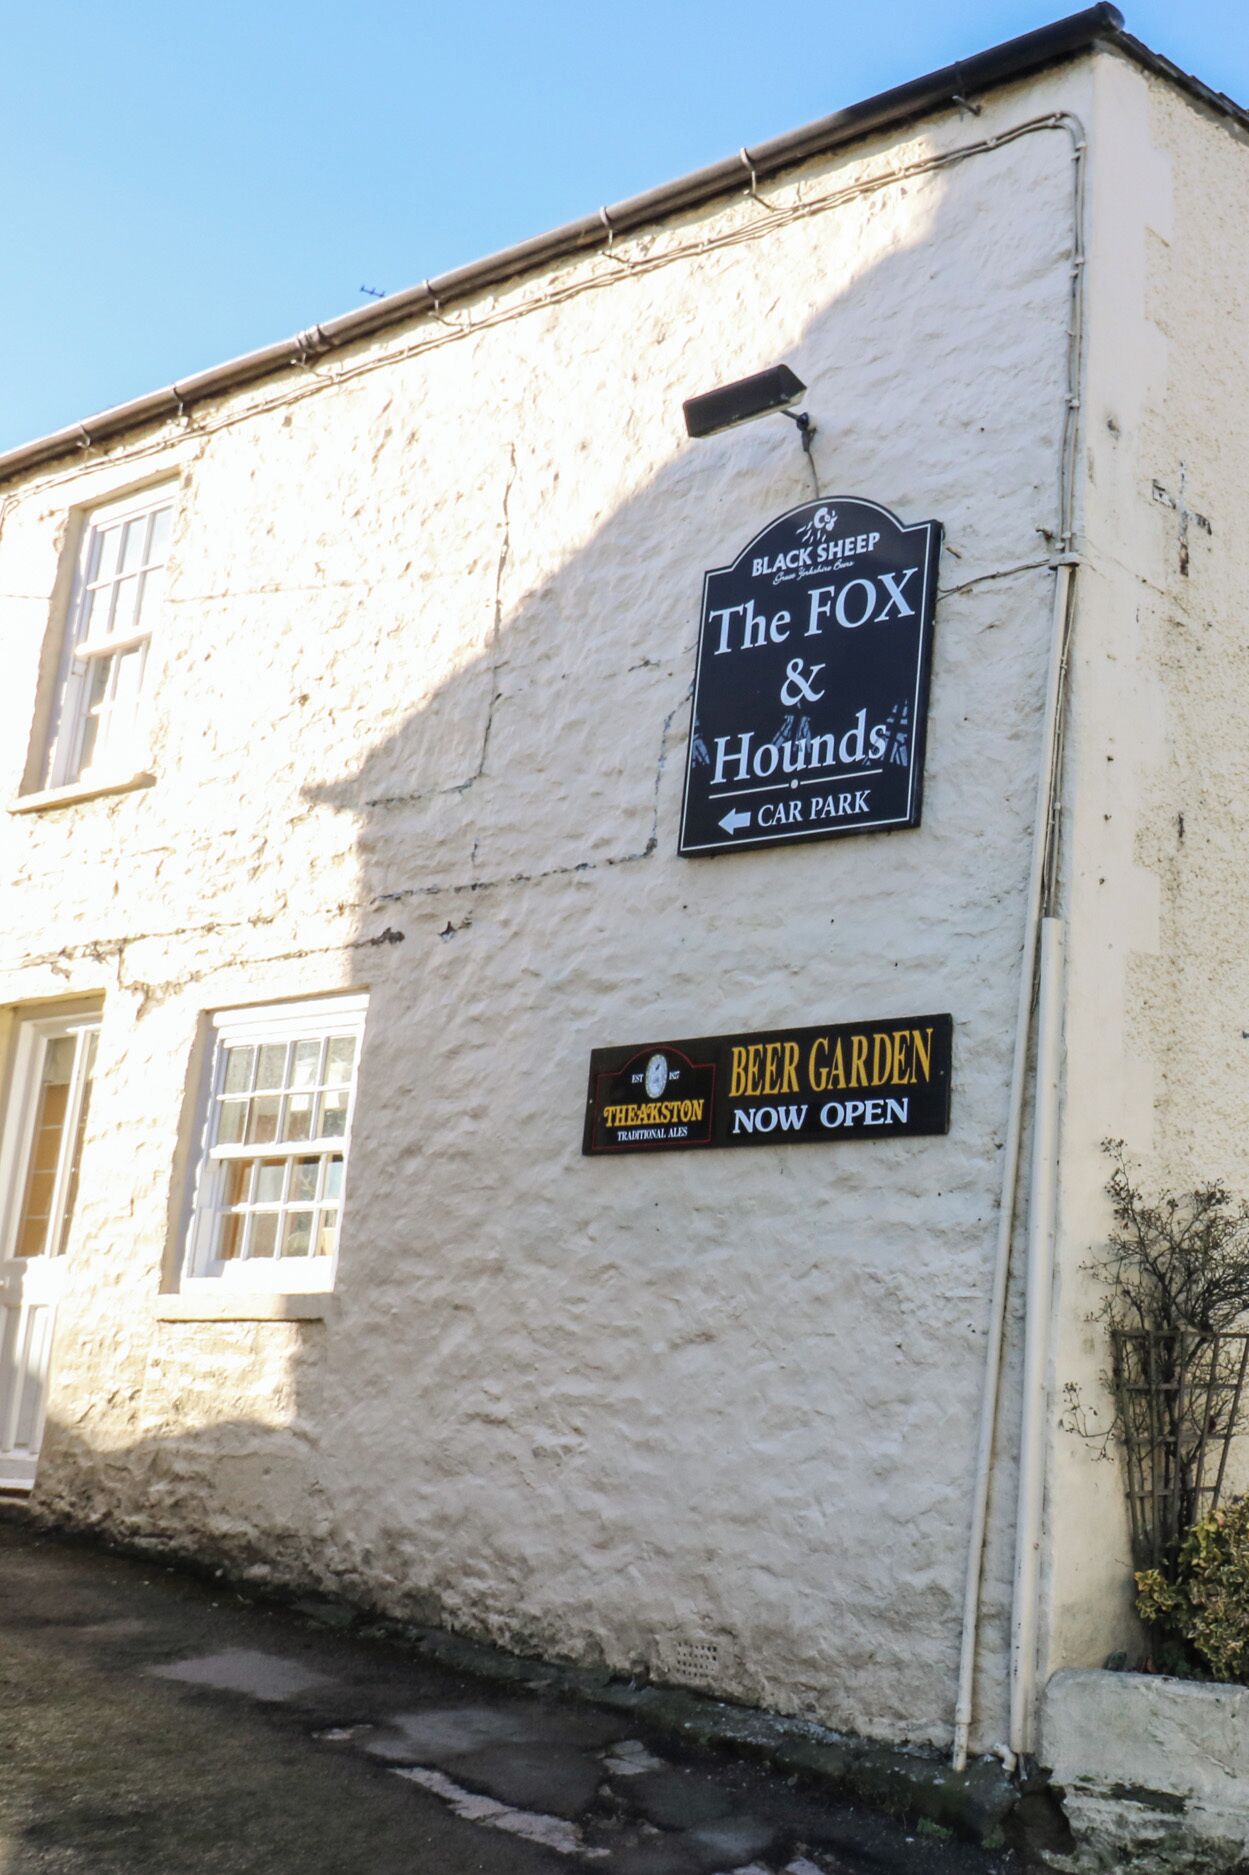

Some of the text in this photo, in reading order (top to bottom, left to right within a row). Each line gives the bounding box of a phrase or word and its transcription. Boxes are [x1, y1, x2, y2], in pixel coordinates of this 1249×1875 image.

[752, 532, 880, 577] BLACK SHEEP
[708, 567, 919, 656] The FOX
[780, 657, 826, 706] &
[709, 708, 887, 786] Hounds
[757, 789, 872, 827] CAR PARK
[631, 1073, 644, 1083] EST
[728, 1027, 934, 1098] BEER GARDEN
[603, 1099, 705, 1128] THEAKSTON
[617, 1126, 688, 1142] TRADITIONAL ALES
[732, 1097, 909, 1134] NOW OPEN
